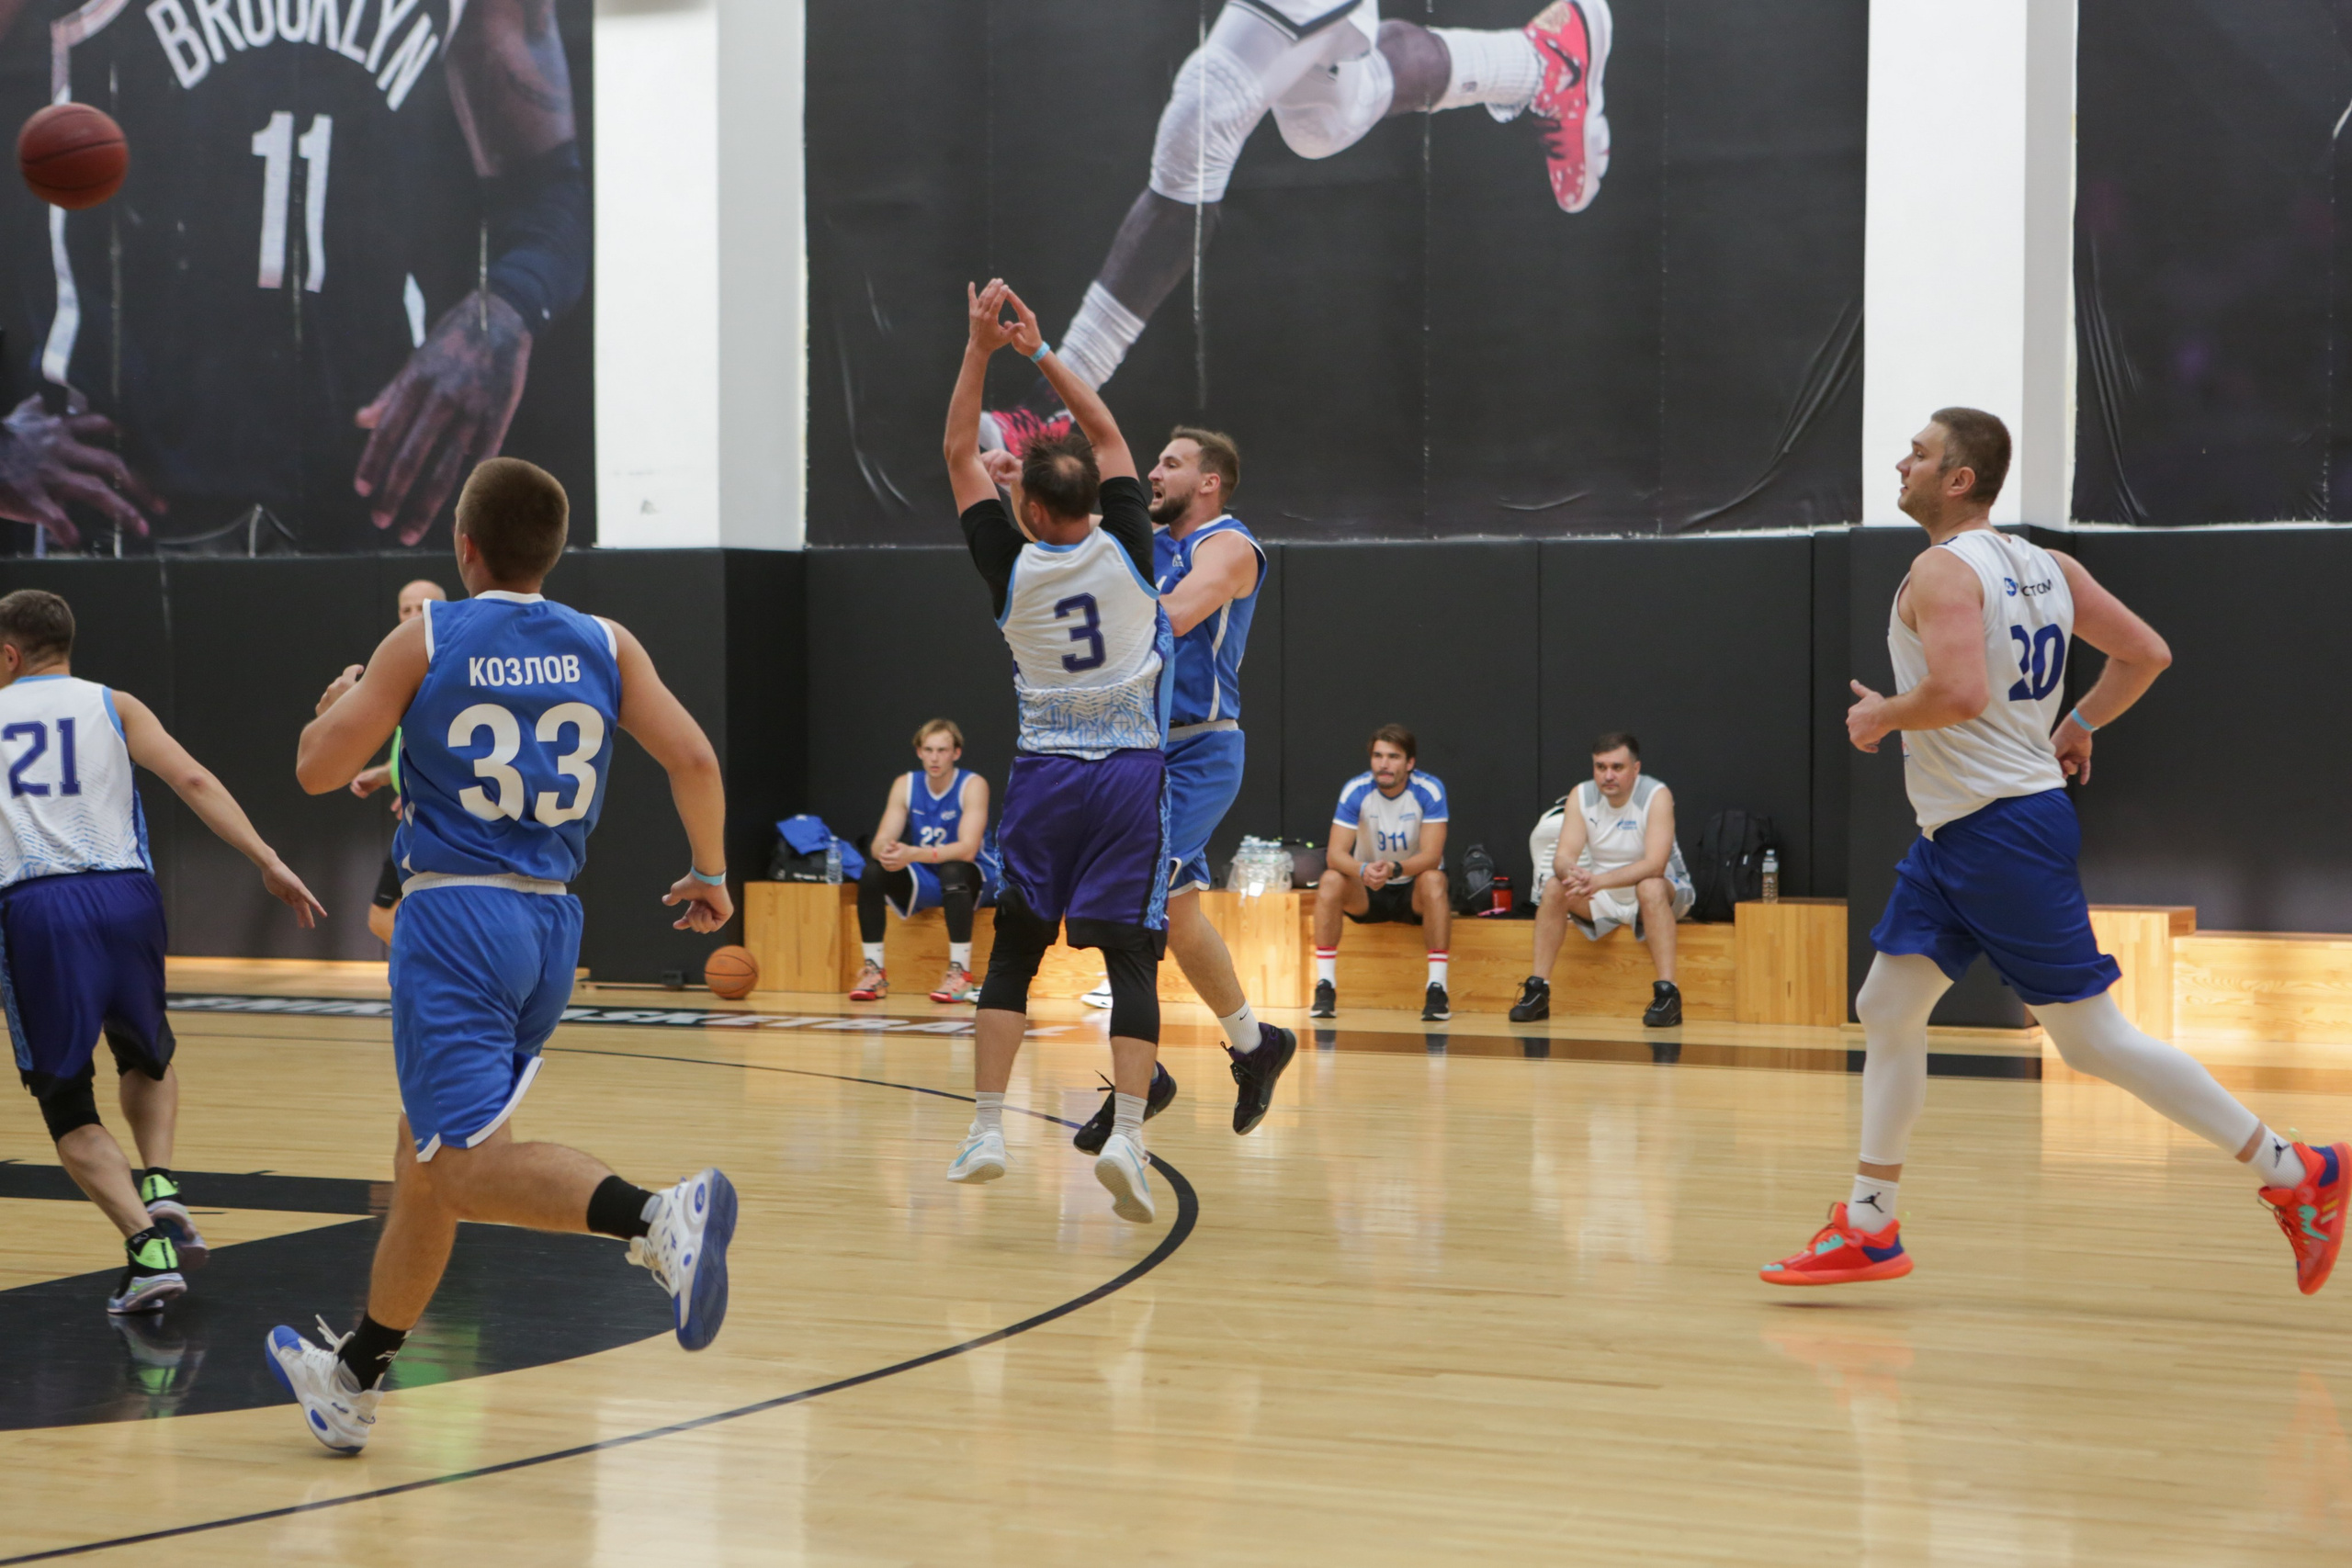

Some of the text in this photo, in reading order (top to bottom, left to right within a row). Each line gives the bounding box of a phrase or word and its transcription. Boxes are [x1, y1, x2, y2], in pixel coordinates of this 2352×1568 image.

[252, 110, 333, 293] 11
[469, 654, 581, 686] КОЗЛОВ
[1054, 592, 1106, 673] 3
[2008, 623, 2065, 702] 20
[1, 716, 82, 799] 21
[447, 702, 605, 827] 33
[921, 826, 947, 848] 22
